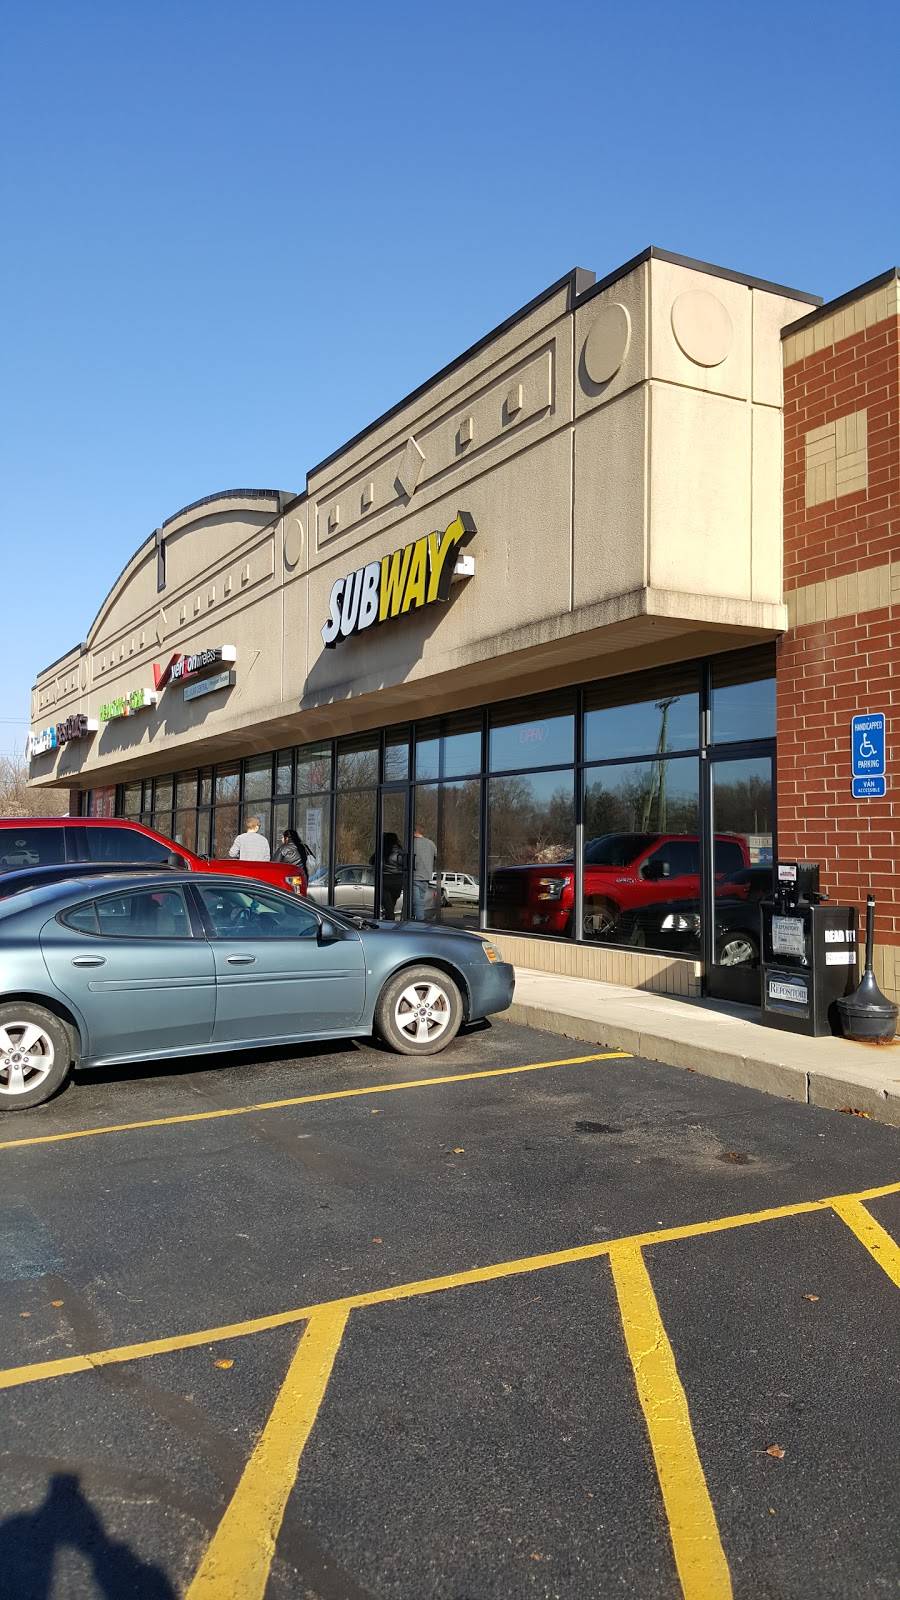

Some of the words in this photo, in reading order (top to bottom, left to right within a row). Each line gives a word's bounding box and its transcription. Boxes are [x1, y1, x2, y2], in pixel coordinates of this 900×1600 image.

[320, 511, 473, 645] SUBWAY
[854, 721, 883, 732] HANDICAPPED
[857, 760, 880, 769] PARKING
[863, 780, 875, 788] VAN
